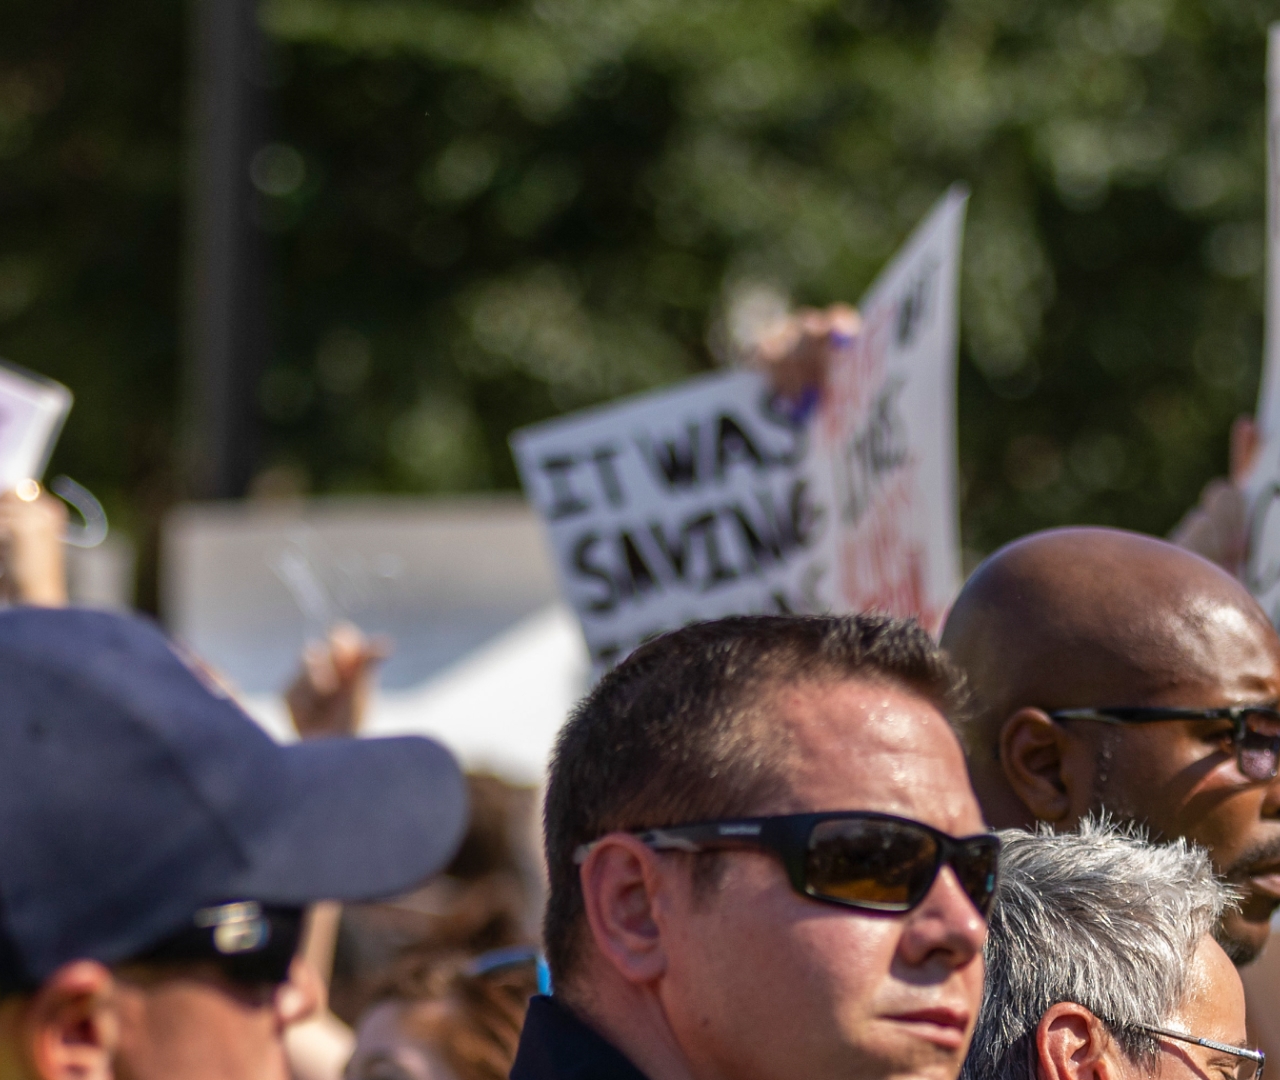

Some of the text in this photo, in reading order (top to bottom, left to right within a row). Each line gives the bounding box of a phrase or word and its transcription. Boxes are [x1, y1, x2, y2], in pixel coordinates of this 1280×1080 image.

[540, 446, 622, 522] IT
[632, 400, 810, 492] WAS
[571, 478, 828, 616] SAVING
